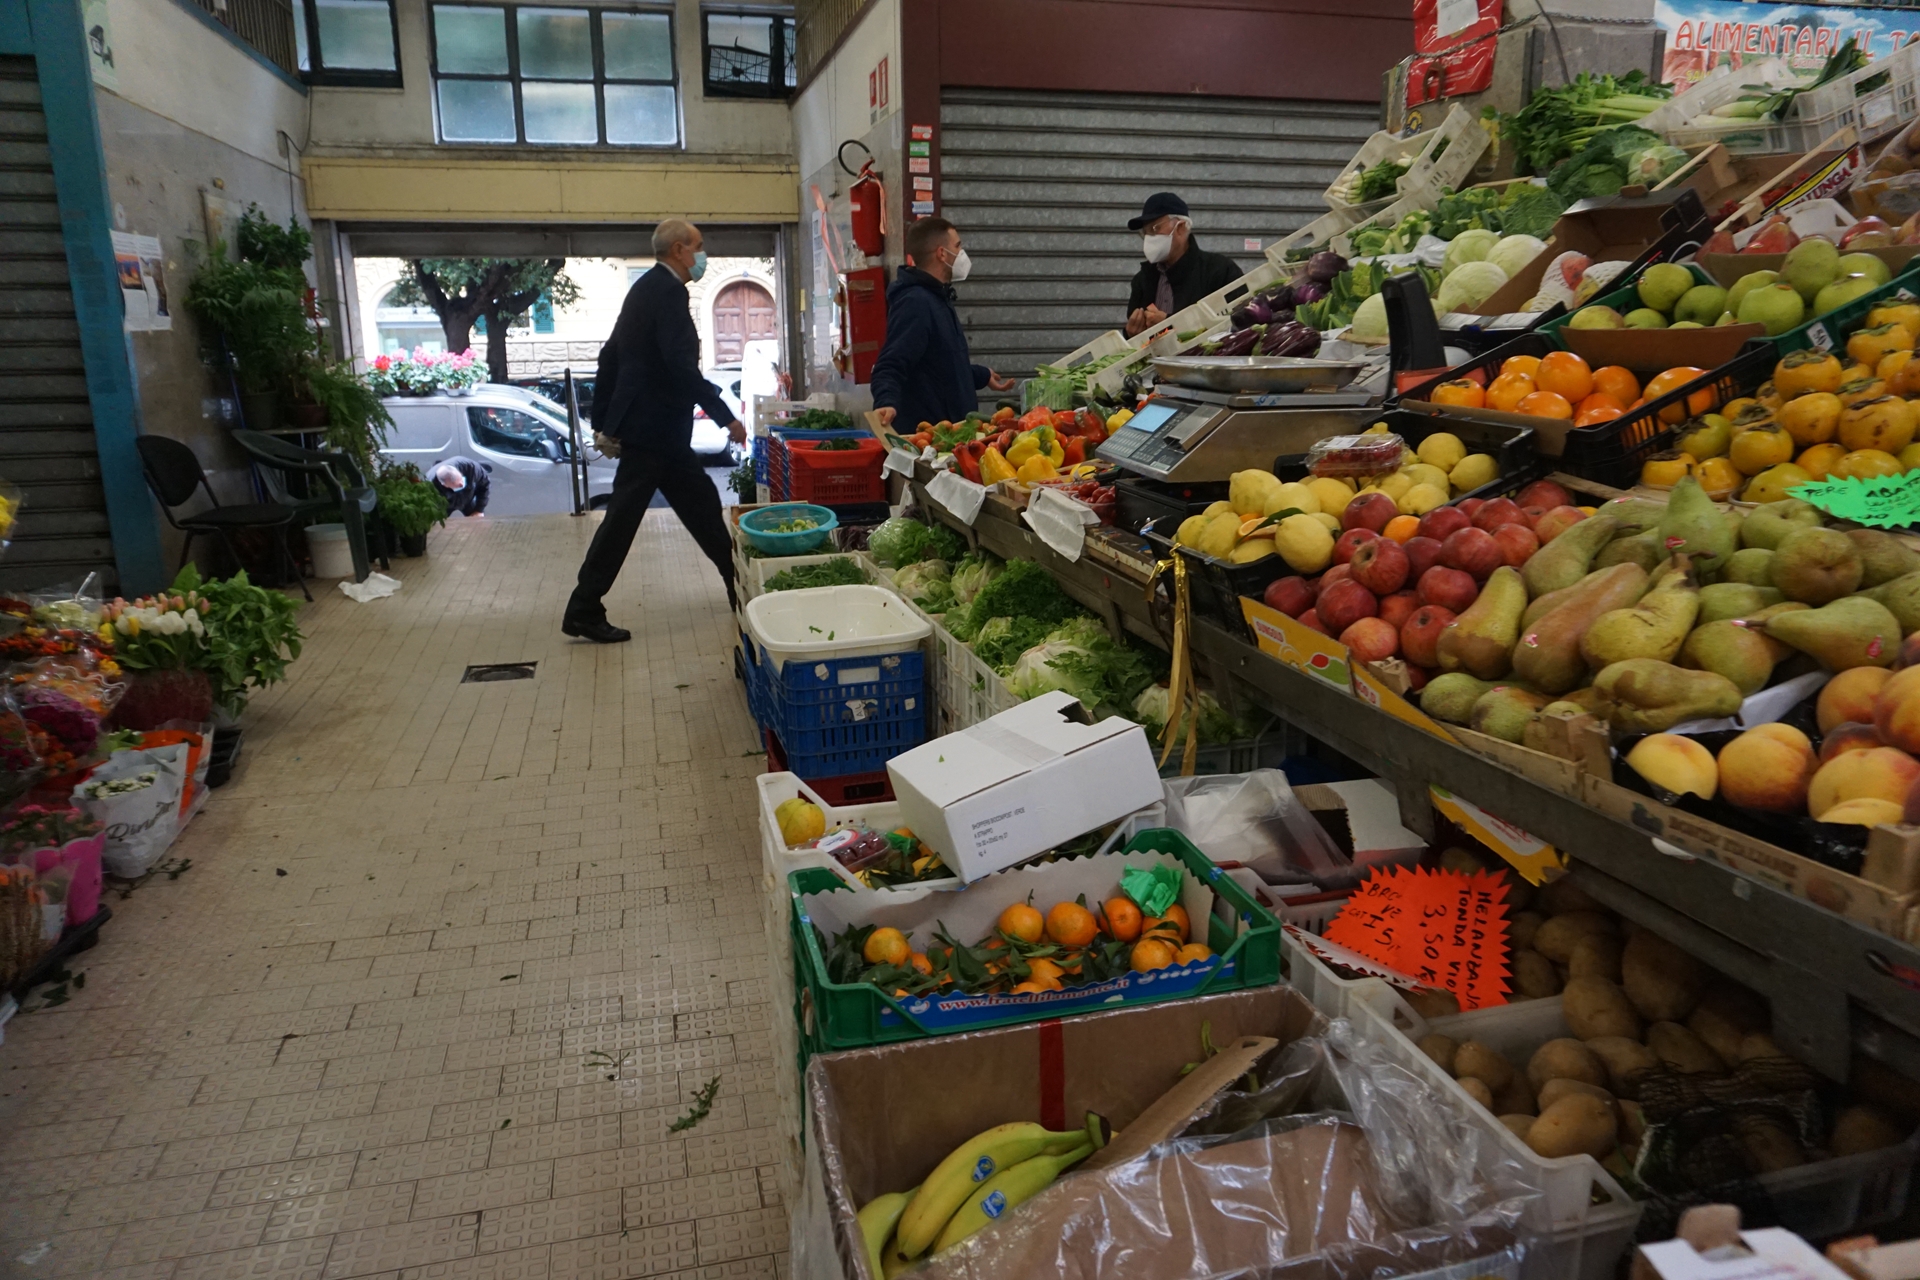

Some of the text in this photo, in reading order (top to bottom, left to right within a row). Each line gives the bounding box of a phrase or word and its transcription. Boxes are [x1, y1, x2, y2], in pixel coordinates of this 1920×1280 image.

[1675, 19, 1841, 58] ALIMENTARI
[1889, 30, 1920, 51] T
[1452, 886, 1472, 947] TONDA
